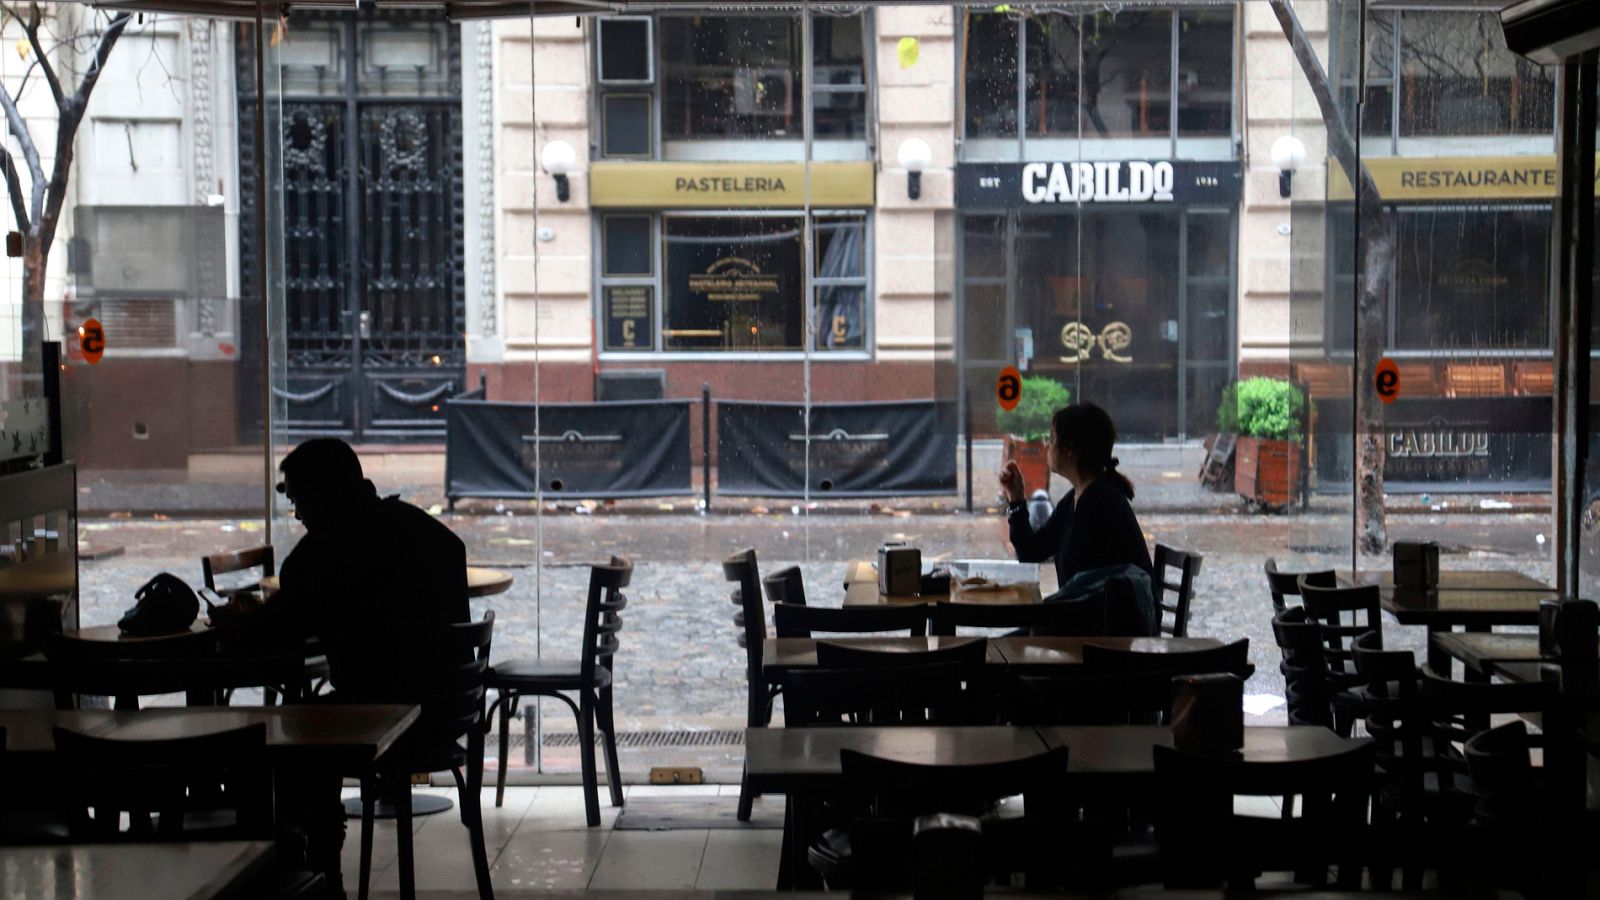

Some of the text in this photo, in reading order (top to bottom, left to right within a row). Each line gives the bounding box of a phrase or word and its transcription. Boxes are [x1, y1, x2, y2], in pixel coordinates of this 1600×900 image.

[675, 177, 786, 192] PASTELERIA
[1022, 161, 1173, 202] CABILDO
[1402, 170, 1555, 187] RESTAURANTE
[1388, 430, 1488, 457] CABILDO
